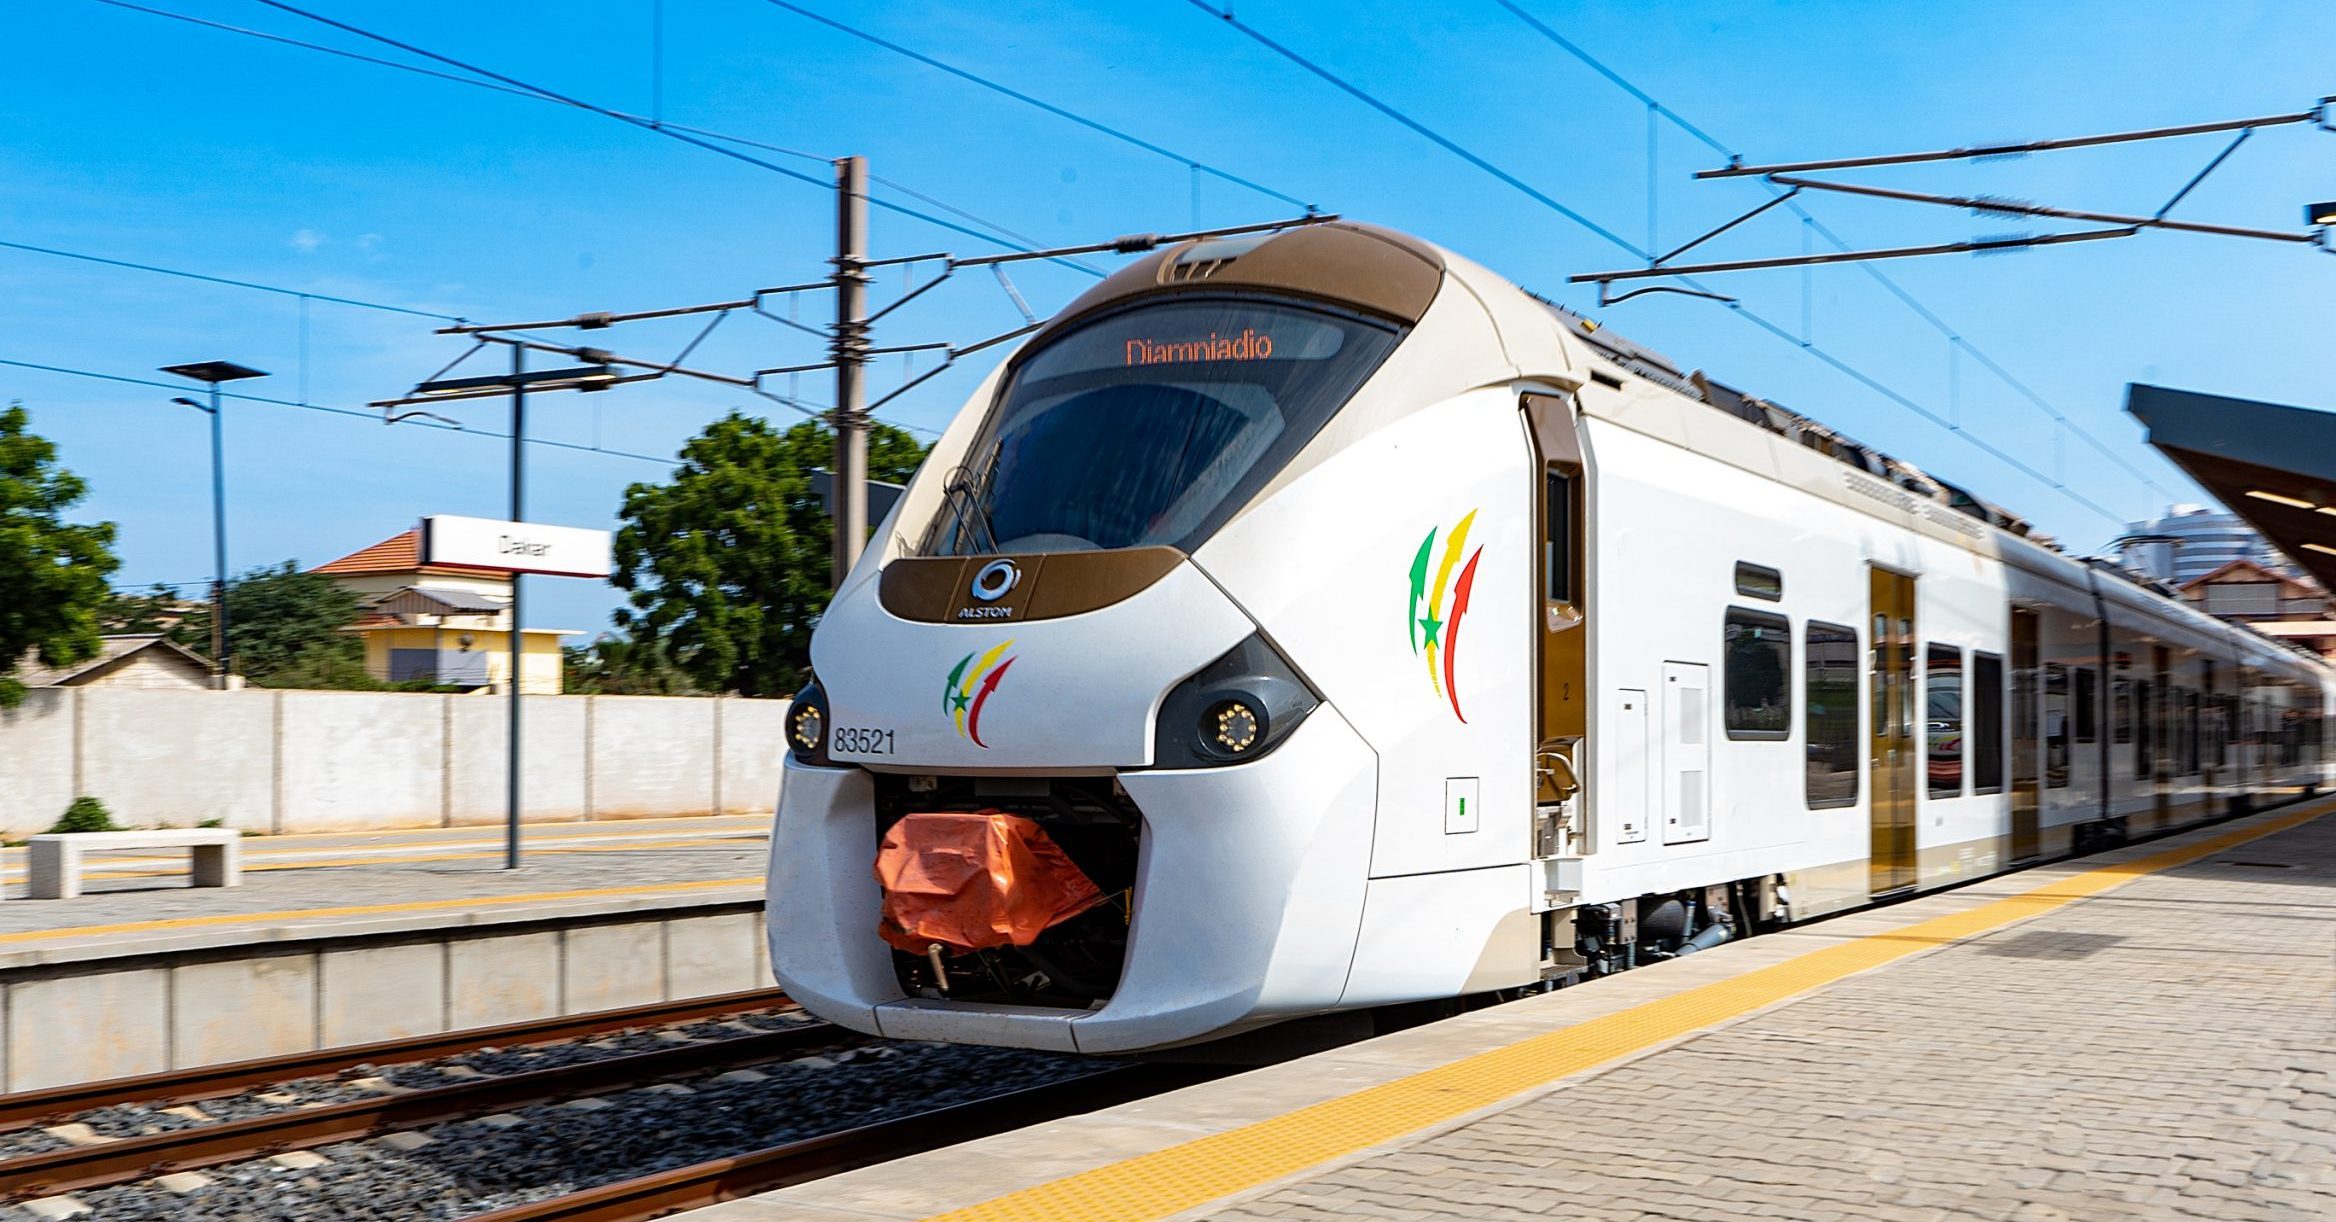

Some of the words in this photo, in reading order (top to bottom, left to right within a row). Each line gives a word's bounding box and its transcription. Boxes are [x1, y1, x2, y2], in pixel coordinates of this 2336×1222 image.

[1126, 328, 1272, 366] Diamniadio
[499, 534, 551, 557] Dakar
[958, 606, 1013, 618] ALSTOM
[835, 727, 894, 754] 83521
